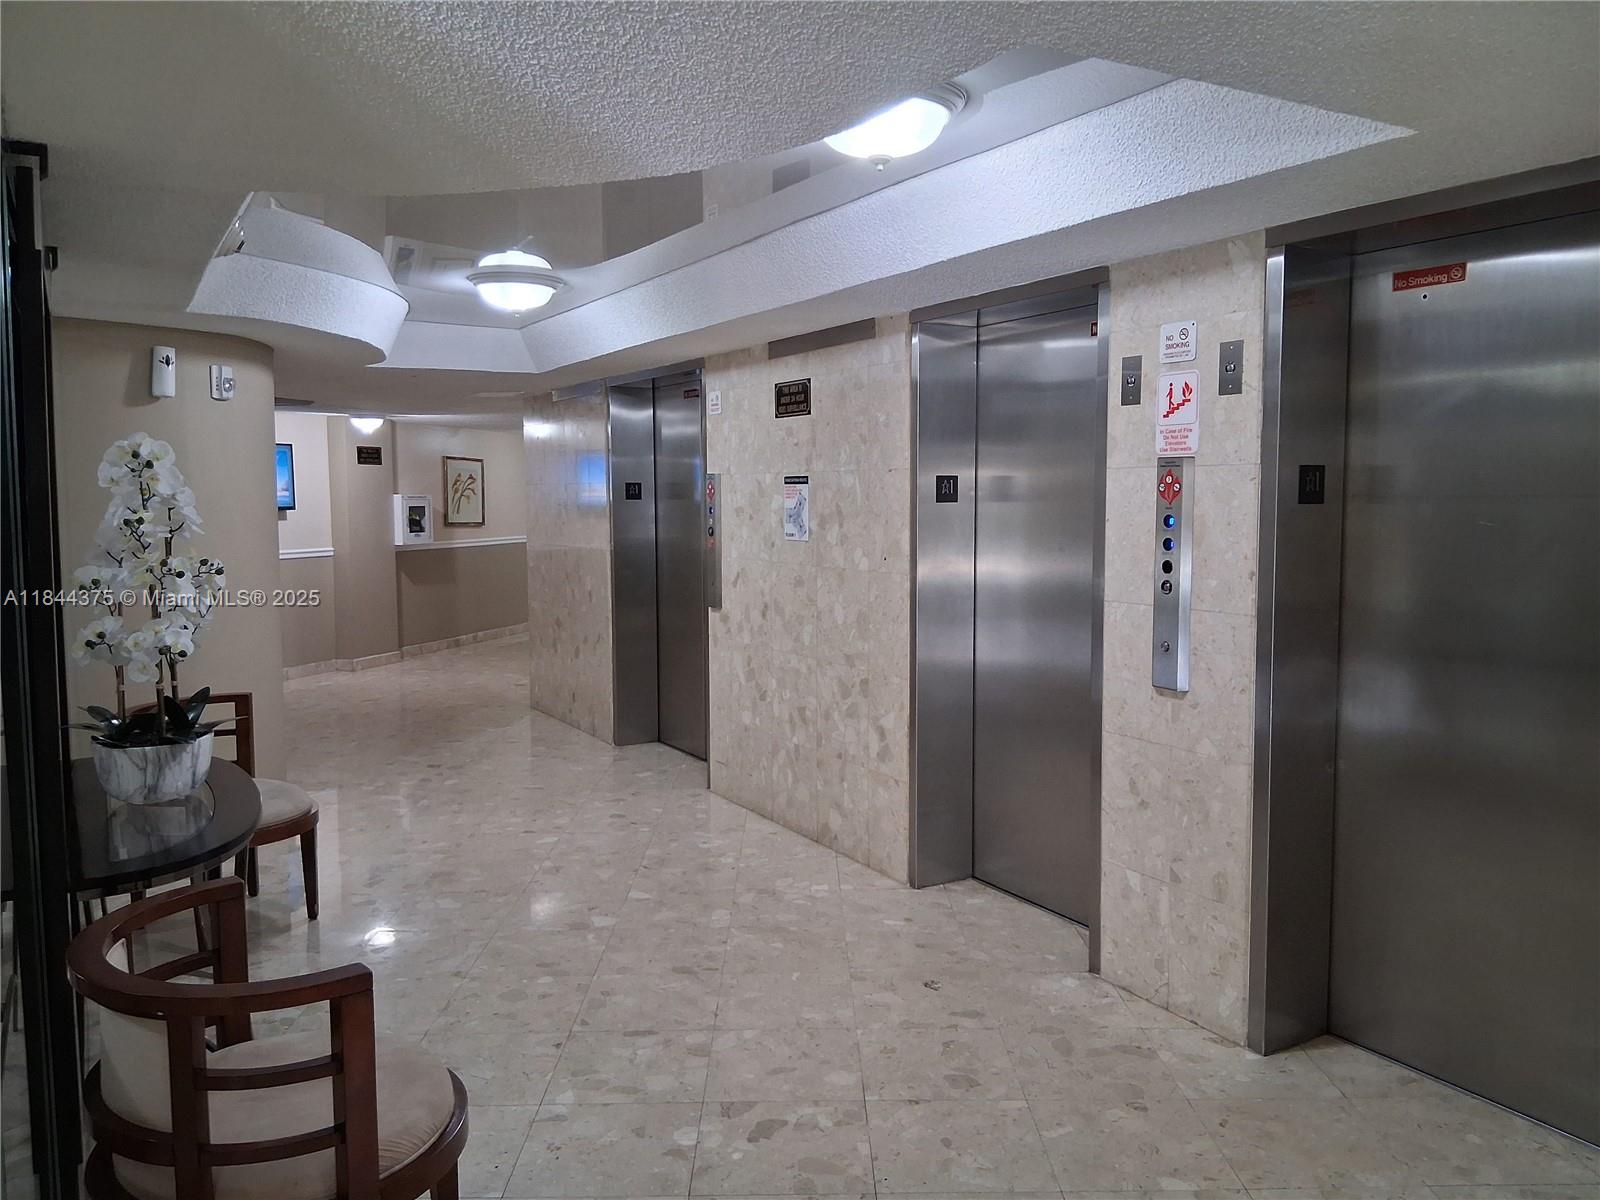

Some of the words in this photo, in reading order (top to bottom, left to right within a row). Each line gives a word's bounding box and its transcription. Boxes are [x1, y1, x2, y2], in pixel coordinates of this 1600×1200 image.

[1394, 280, 1407, 289] No
[1408, 273, 1448, 287] Smoking
[1165, 341, 1190, 350] SMOKING
